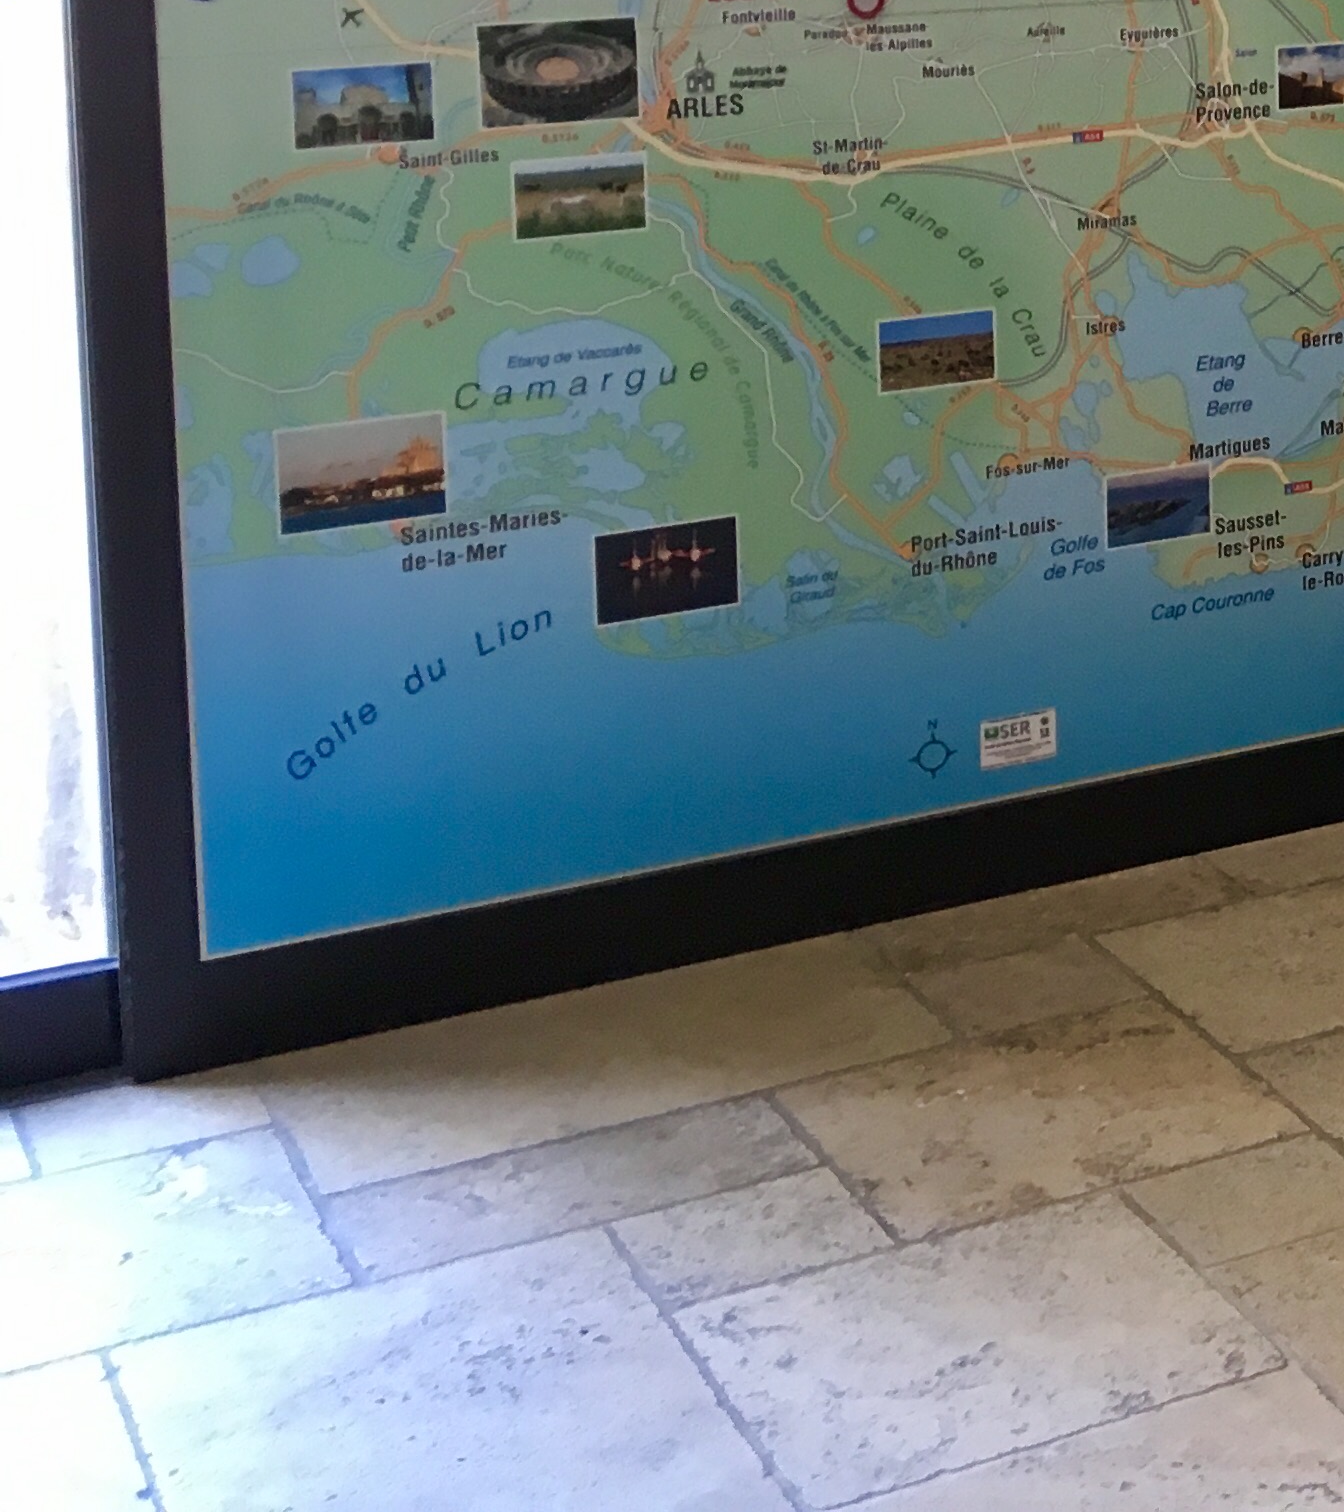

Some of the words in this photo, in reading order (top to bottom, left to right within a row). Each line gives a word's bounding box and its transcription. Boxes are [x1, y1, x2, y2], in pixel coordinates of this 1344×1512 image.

[1119, 25, 1180, 43] Eyguières
[922, 64, 976, 79] Mouriès
[1195, 81, 1275, 101] Salon-de-
[666, 93, 745, 120] ARLES
[1195, 102, 1272, 124] Provence
[398, 148, 500, 170] Saint-Gilles
[1076, 213, 1138, 231] Miramas
[881, 191, 951, 242] Plaine
[957, 242, 986, 271] de
[988, 276, 1011, 301] la
[1010, 307, 1048, 360] Crau
[1085, 317, 1126, 336] Istres
[506, 351, 550, 370] Etang
[1195, 352, 1246, 374] Etang
[454, 359, 709, 411] Camargue
[1212, 376, 1236, 393] de
[1205, 397, 1253, 417] Berre
[1189, 434, 1272, 462] Martigues
[985, 456, 1071, 480] Fos-sur-Mer
[400, 509, 569, 547] Saintes-Maries-
[909, 517, 1064, 553] Port-Saint-Louis-
[1214, 512, 1287, 535] Sausset-
[401, 540, 508, 574] de-la-Mer
[1049, 533, 1100, 558] Golfe
[1217, 533, 1285, 559] les-Pins
[909, 548, 999, 579] du-Rhône
[1042, 561, 1069, 581] de
[1072, 557, 1106, 577] Fos
[1151, 600, 1193, 622] Cap
[1197, 585, 1275, 615] Couronne
[285, 699, 379, 781] Golfe
[403, 657, 447, 696] du
[473, 607, 553, 657] Lion
[927, 719, 938, 731] N
